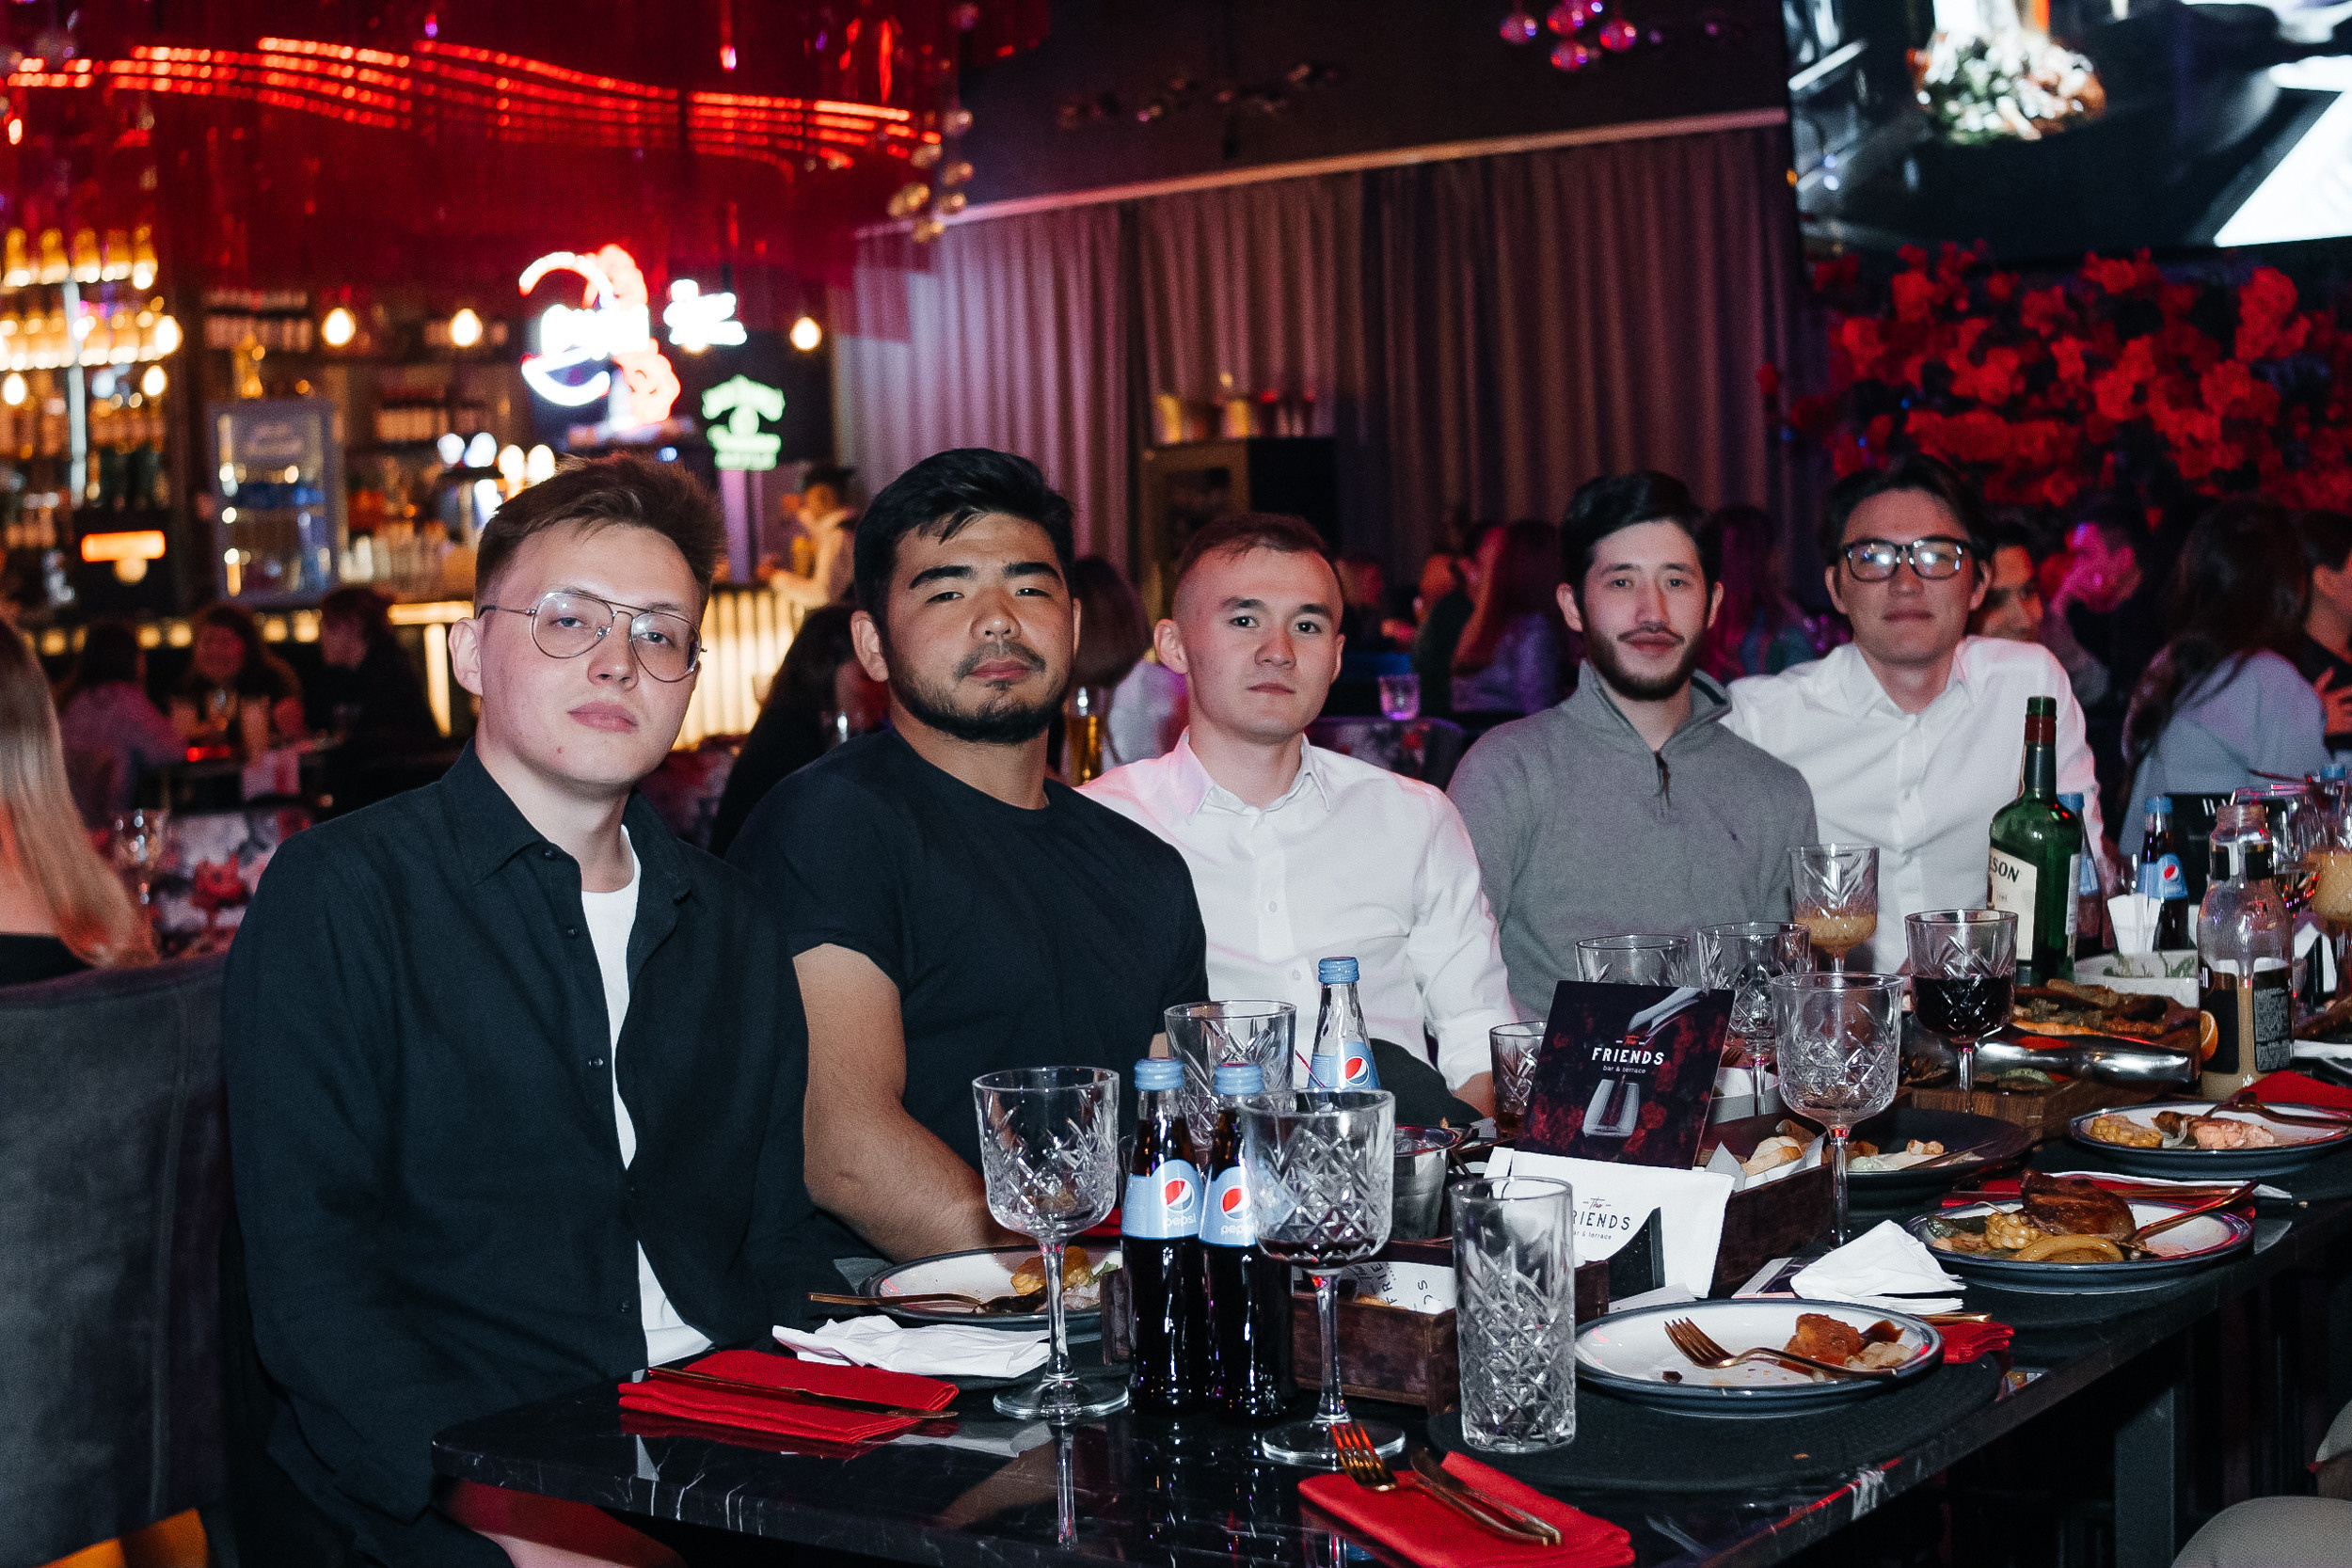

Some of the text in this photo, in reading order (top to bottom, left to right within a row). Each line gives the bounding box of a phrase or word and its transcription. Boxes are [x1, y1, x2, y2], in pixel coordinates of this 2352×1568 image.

[1990, 857, 2020, 882] SON
[1591, 1047, 1665, 1066] FRIENDS
[1165, 1212, 1197, 1228] pepsi
[1220, 1223, 1254, 1235] pep
